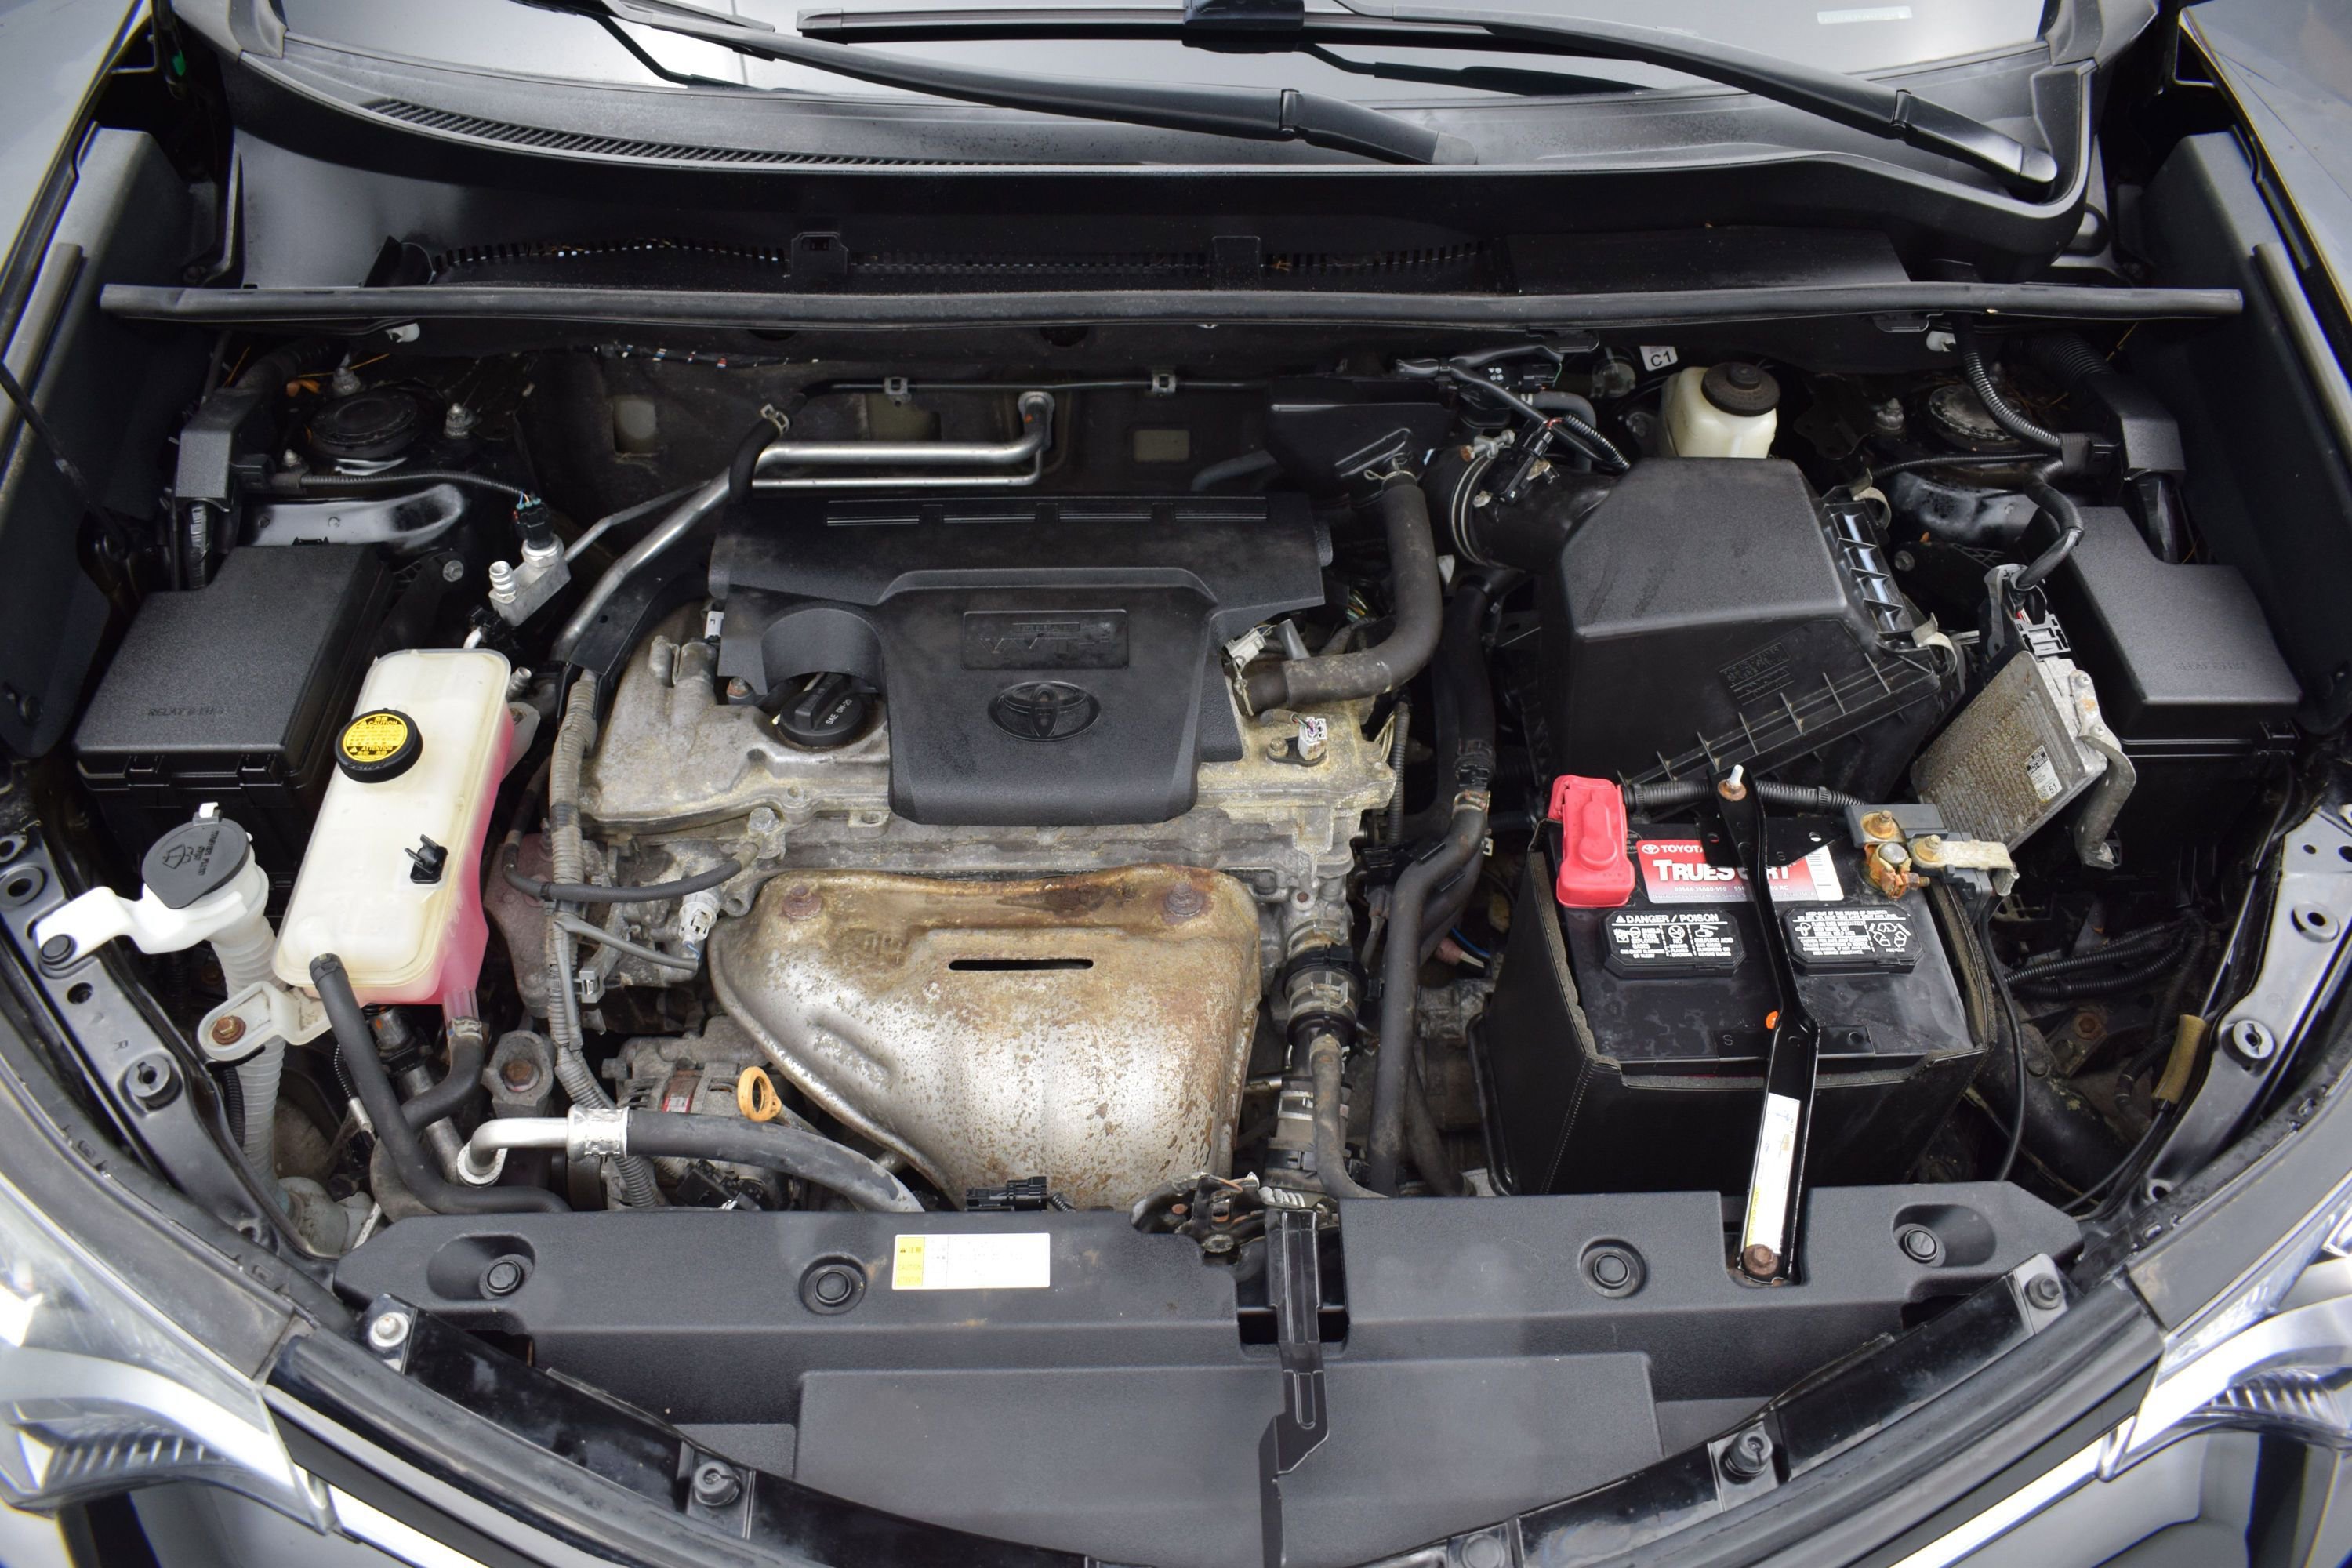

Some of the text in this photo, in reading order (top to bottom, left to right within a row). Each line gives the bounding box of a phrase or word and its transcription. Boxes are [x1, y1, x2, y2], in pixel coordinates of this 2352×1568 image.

[1650, 350, 1672, 367] C1
[826, 714, 839, 725] SAE
[2048, 782, 2058, 794] 51
[1626, 914, 1670, 924] DANGER
[1679, 913, 1719, 922] POISON
